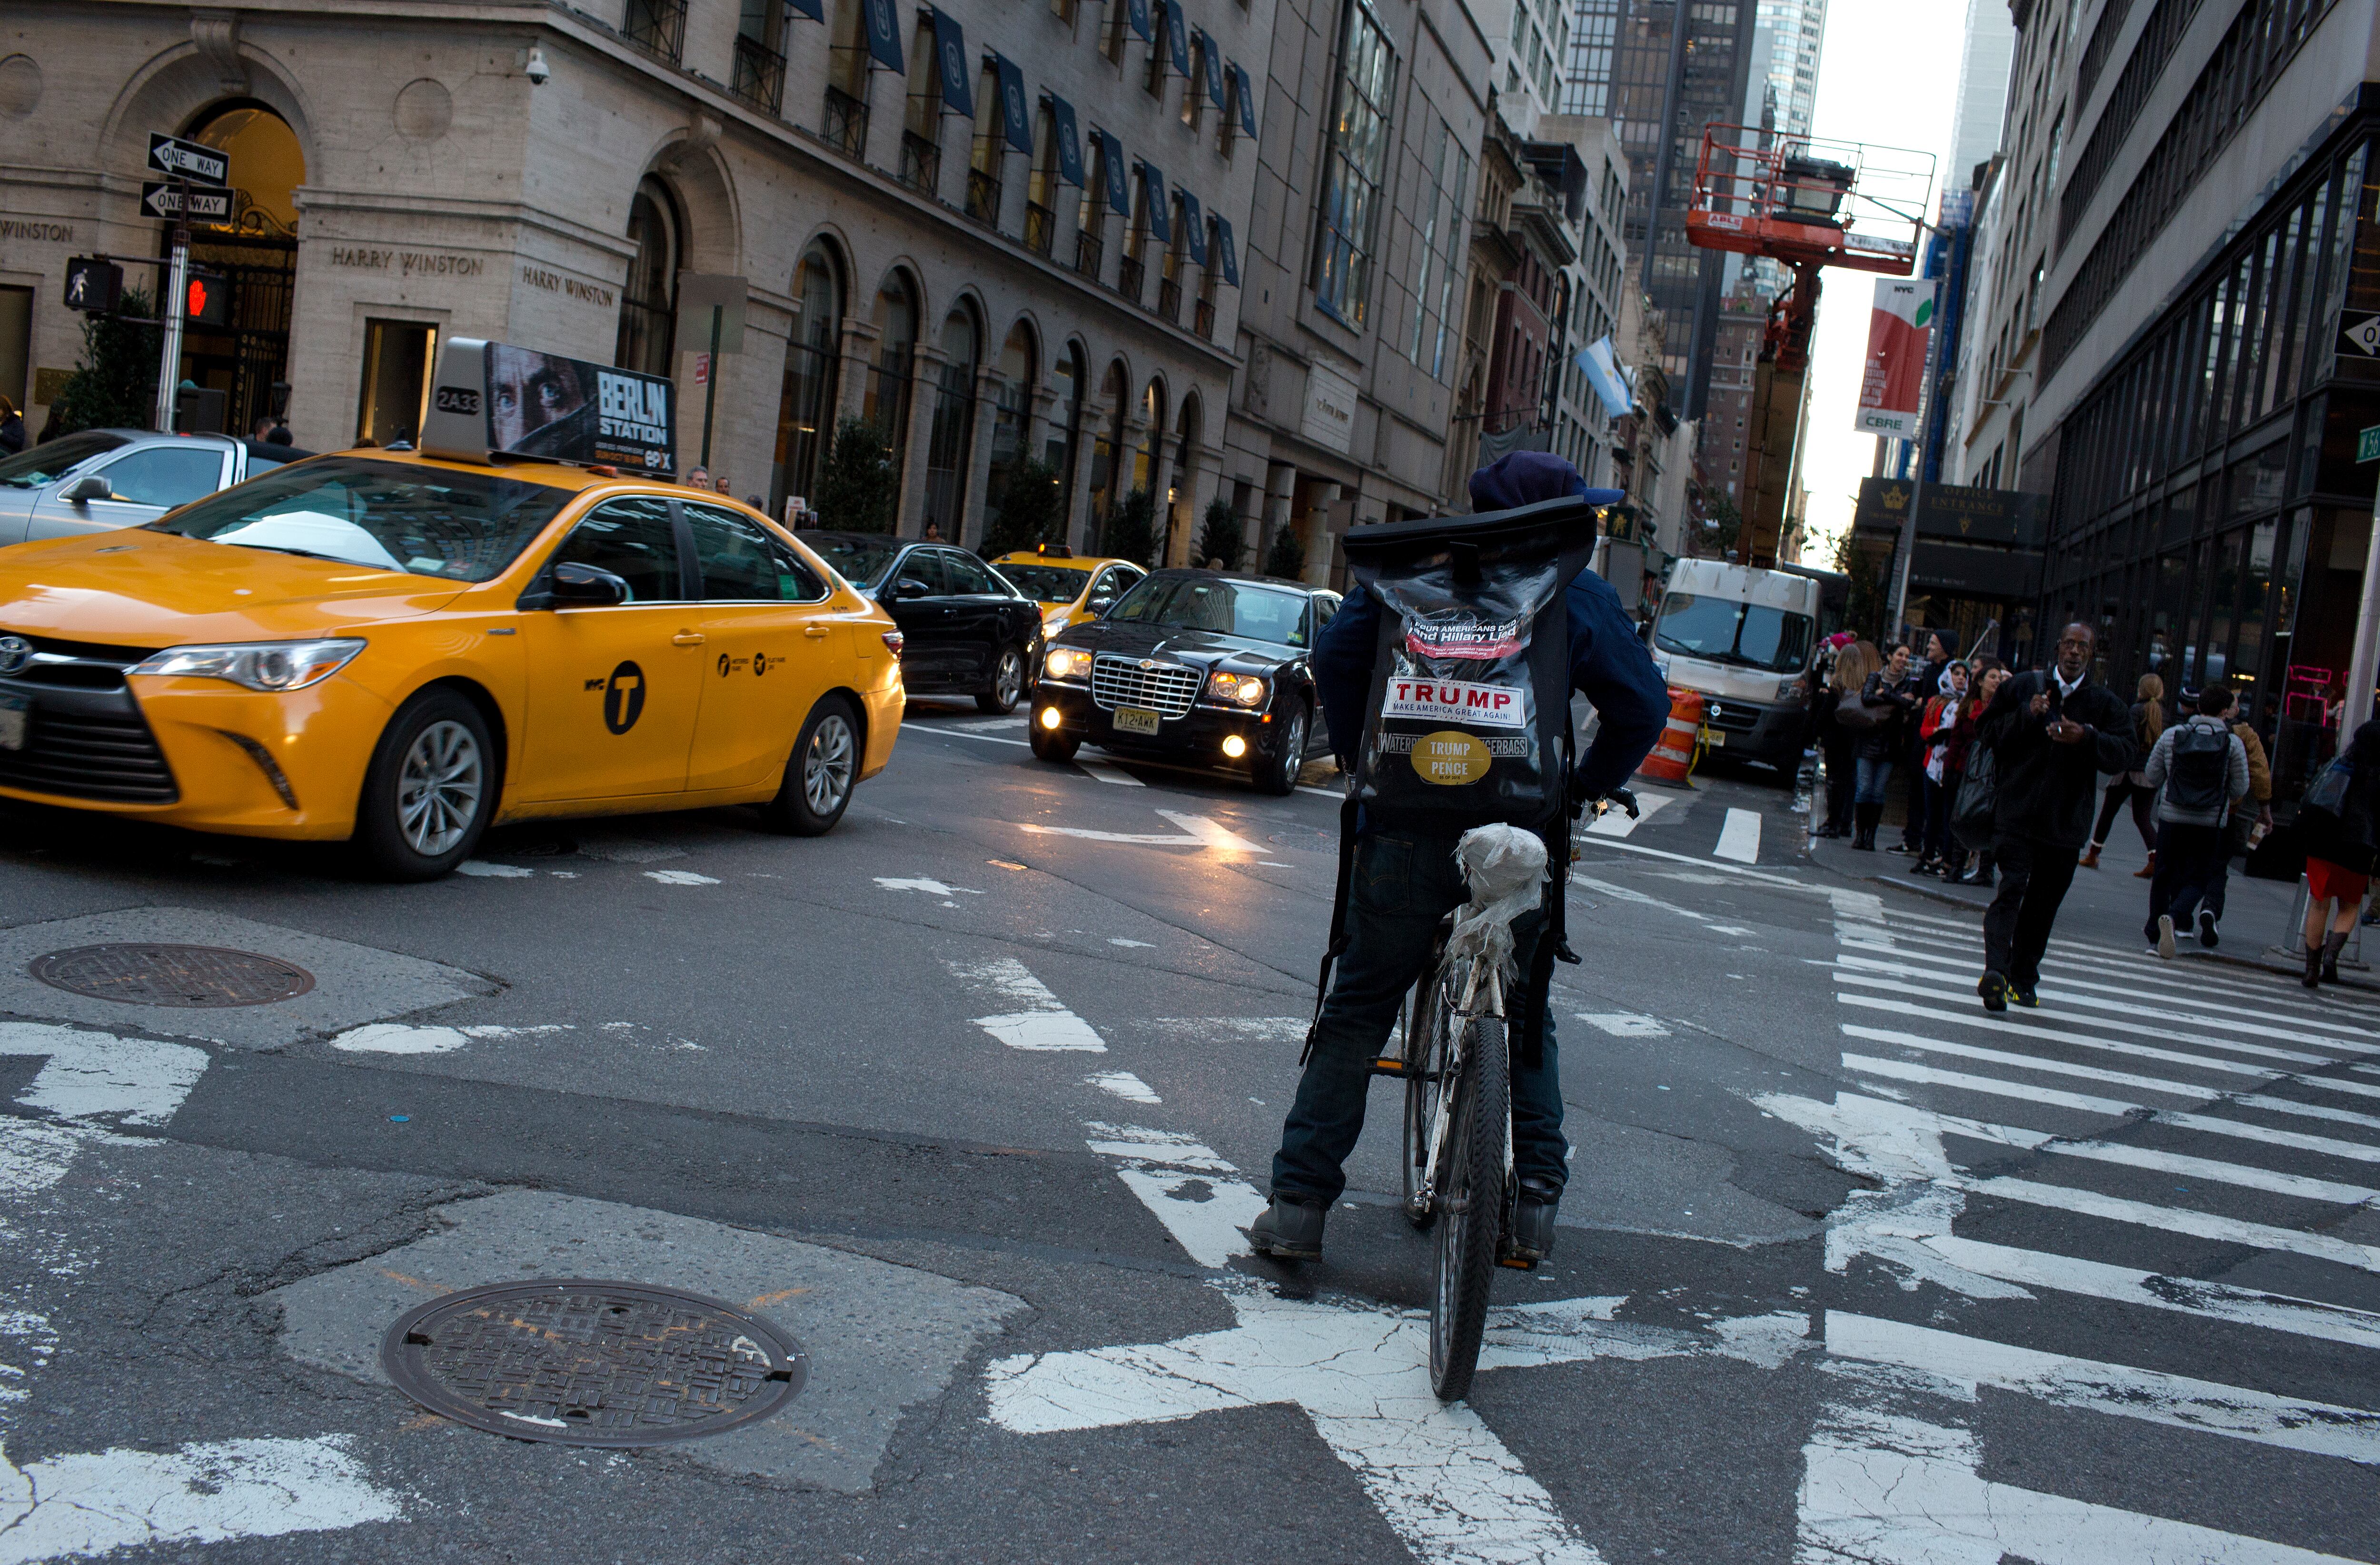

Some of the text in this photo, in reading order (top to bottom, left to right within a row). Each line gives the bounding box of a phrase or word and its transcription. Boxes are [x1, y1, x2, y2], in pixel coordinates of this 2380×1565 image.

[162, 148, 219, 175] ONE WAY
[158, 194, 220, 211] ONE WAY
[1710, 215, 1740, 226] ABLE
[0, 220, 73, 242] WINSTON
[333, 247, 484, 276] HARRY WINSTON
[523, 265, 614, 306] HARRY WINSTON
[598, 371, 667, 428] BERLIN
[600, 417, 668, 445] STATION
[1865, 416, 1903, 430] CBRE
[2359, 431, 2380, 458] W 56
[645, 447, 672, 470] epix
[1944, 485, 1994, 499] OFFICE
[1931, 497, 2004, 513] ENTRANCE
[1440, 632, 1486, 643] Hillary
[1489, 626, 1517, 642] Lied
[1498, 620, 1517, 632] DIED
[1396, 683, 1511, 710] TRUMP
[1393, 703, 1511, 720] MAKE AMERICA GREAT AGAIN!
[1430, 742, 1471, 756] TRUMP
[1431, 762, 1468, 775] PENCE
